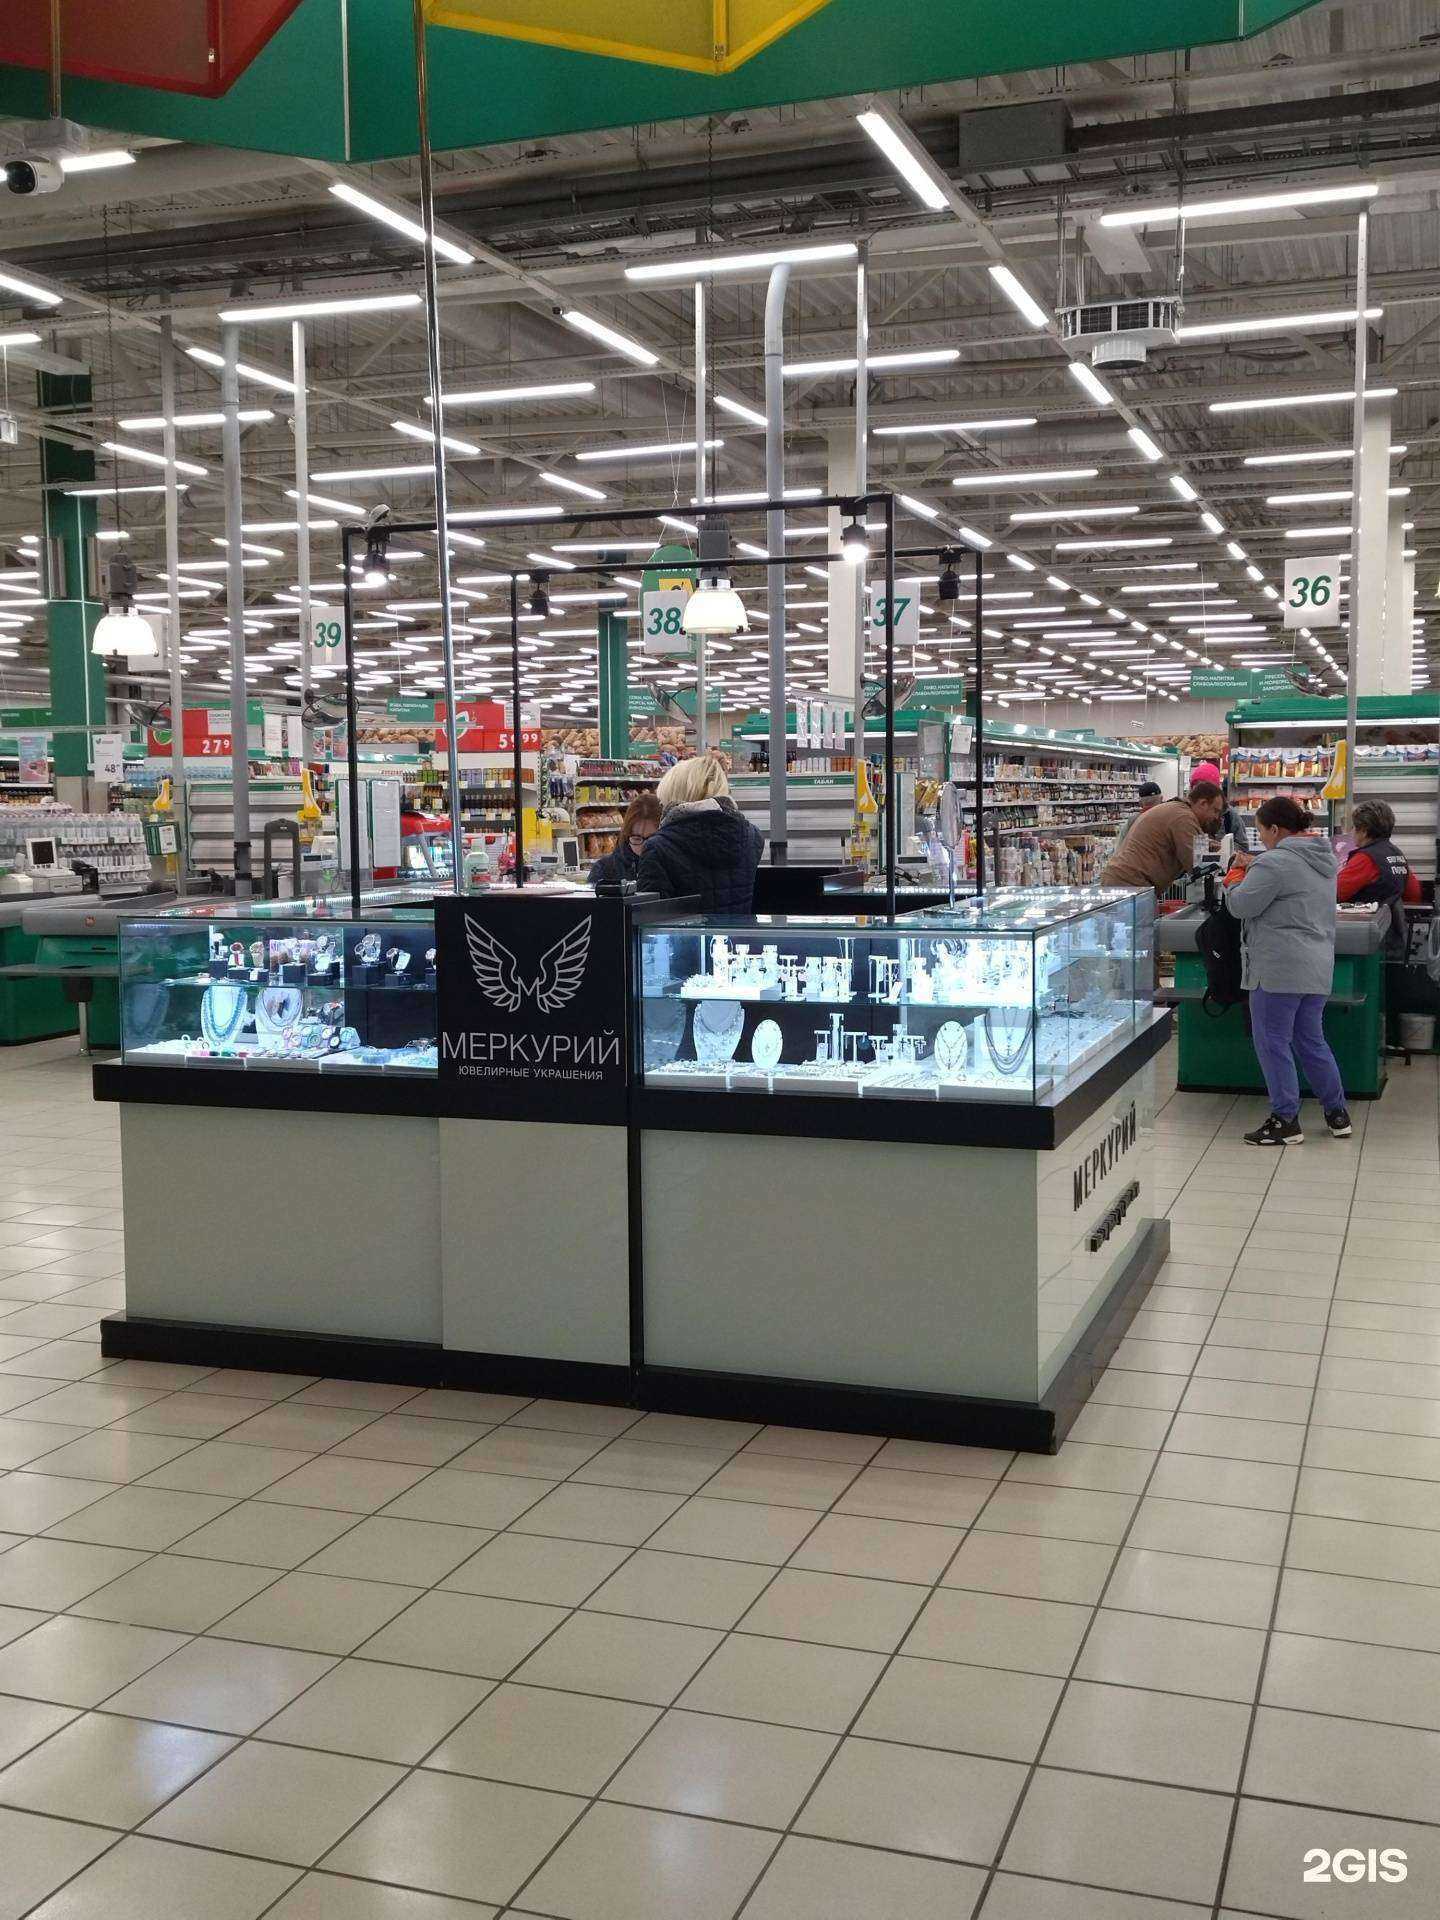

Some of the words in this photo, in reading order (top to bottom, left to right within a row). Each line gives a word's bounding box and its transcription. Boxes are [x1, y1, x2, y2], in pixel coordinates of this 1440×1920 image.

[1289, 575, 1332, 607] 36
[647, 607, 681, 635] 38
[873, 598, 912, 627] 37
[314, 622, 342, 648] 39
[442, 1029, 620, 1065] МЕРКУРИЙ
[458, 1065, 530, 1078] ЮВЕЛИРНЫЕ
[533, 1068, 603, 1081] УКРАШЕНИЯ
[1073, 1100, 1136, 1212] МЕРКУРИЙ
